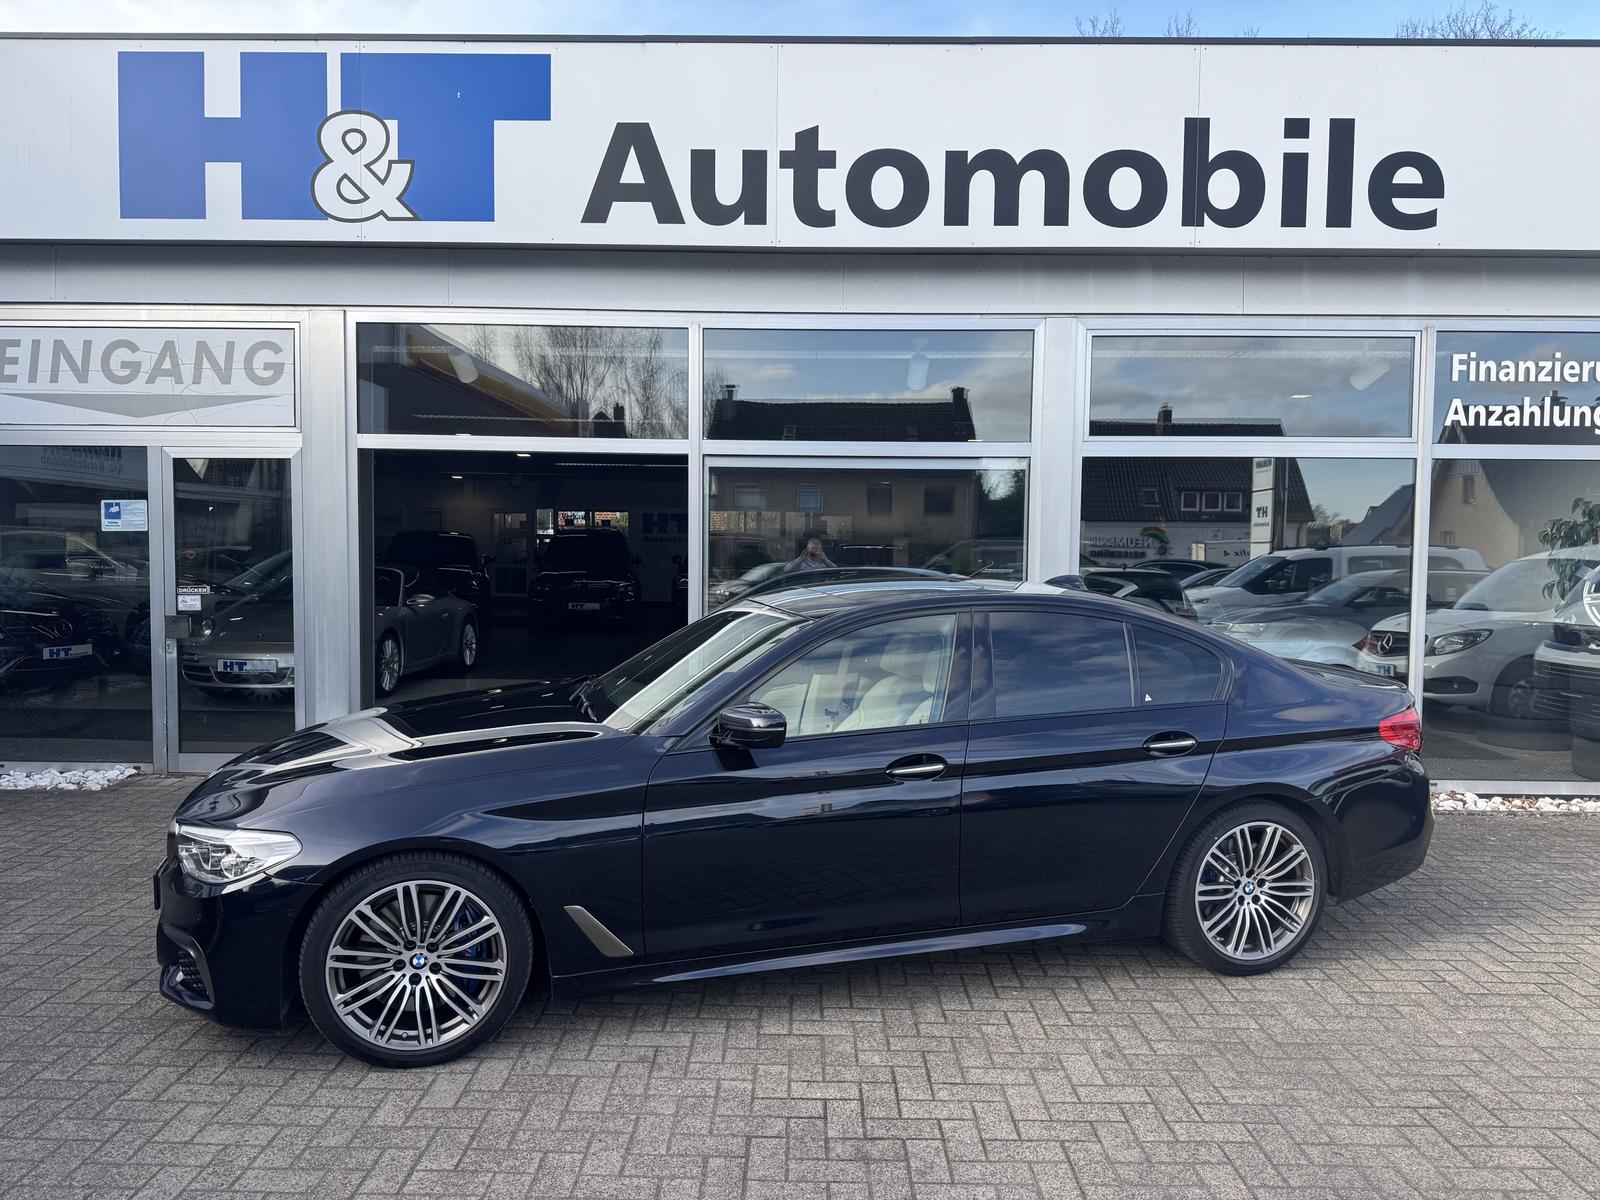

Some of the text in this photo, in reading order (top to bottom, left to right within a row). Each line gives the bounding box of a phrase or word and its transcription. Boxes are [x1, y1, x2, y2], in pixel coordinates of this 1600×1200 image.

[118, 51, 1445, 231] H&T Automobile
[0, 338, 287, 386] EINGANG
